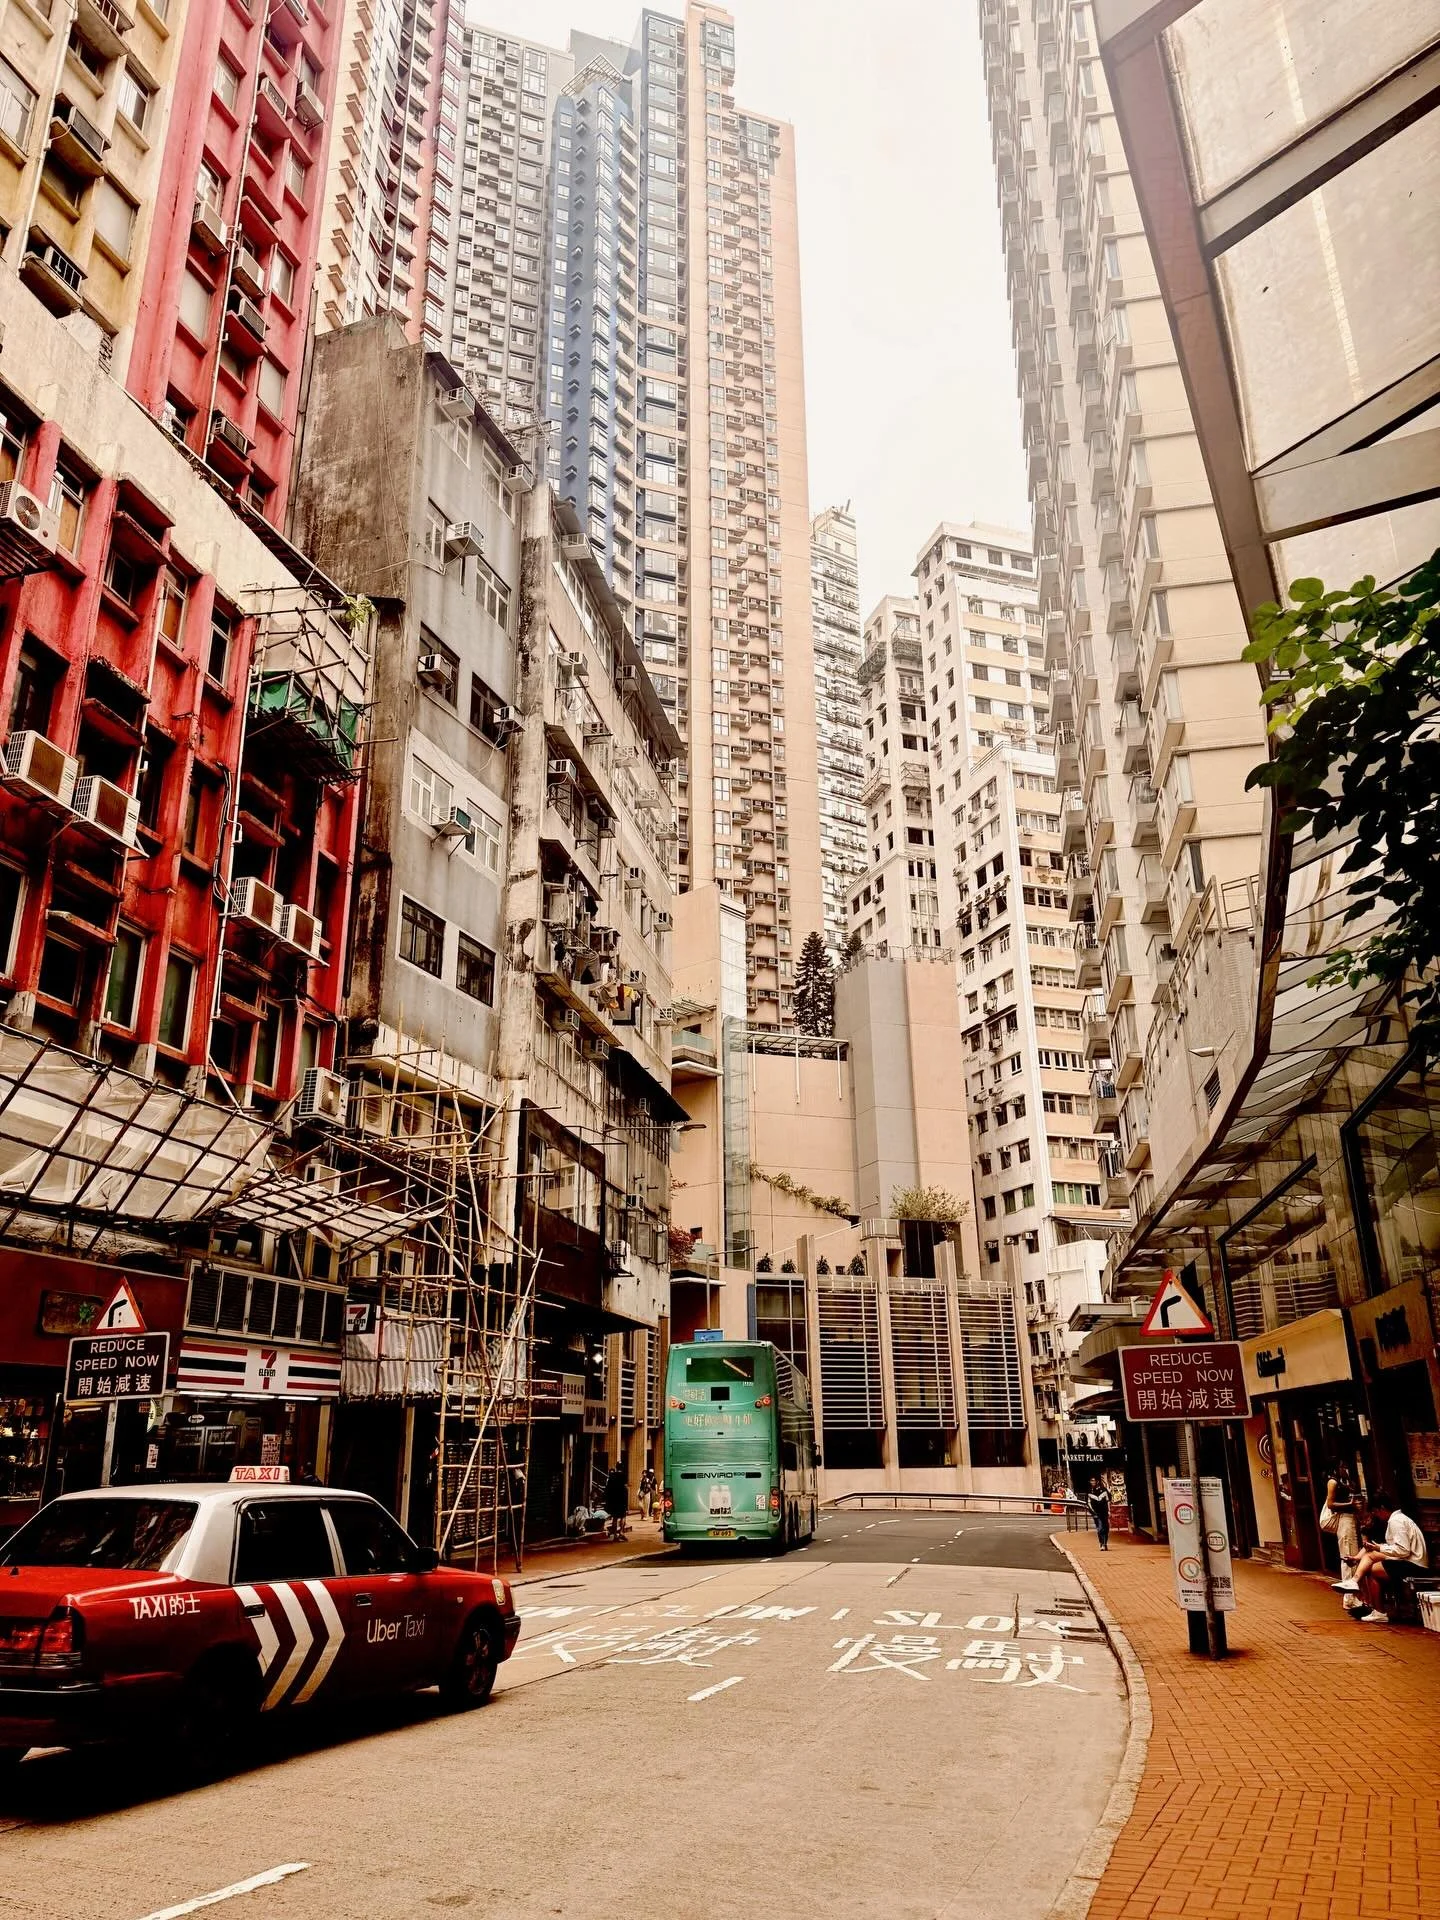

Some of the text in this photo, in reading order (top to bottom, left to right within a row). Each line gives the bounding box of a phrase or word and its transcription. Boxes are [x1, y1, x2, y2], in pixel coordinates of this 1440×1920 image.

[348, 1306, 367, 1331] 7
[90, 1339, 146, 1354] REDUCE
[74, 1354, 160, 1372] SPEED NOW
[261, 1349, 277, 1390] 7
[1149, 1351, 1213, 1367] REDUCE
[76, 1373, 152, 1396] 開始減速
[1132, 1368, 1234, 1385] SPEED NOW
[1136, 1387, 1237, 1411] 開始減速
[1062, 1454, 1104, 1462] MARKET PLACE
[235, 1467, 281, 1480] TAXI
[128, 1591, 201, 1620] TAXI 的士
[366, 1613, 426, 1644] Uber Taxi
[872, 1609, 1072, 1636] SLOW
[825, 1633, 1091, 1695] 慢駛
